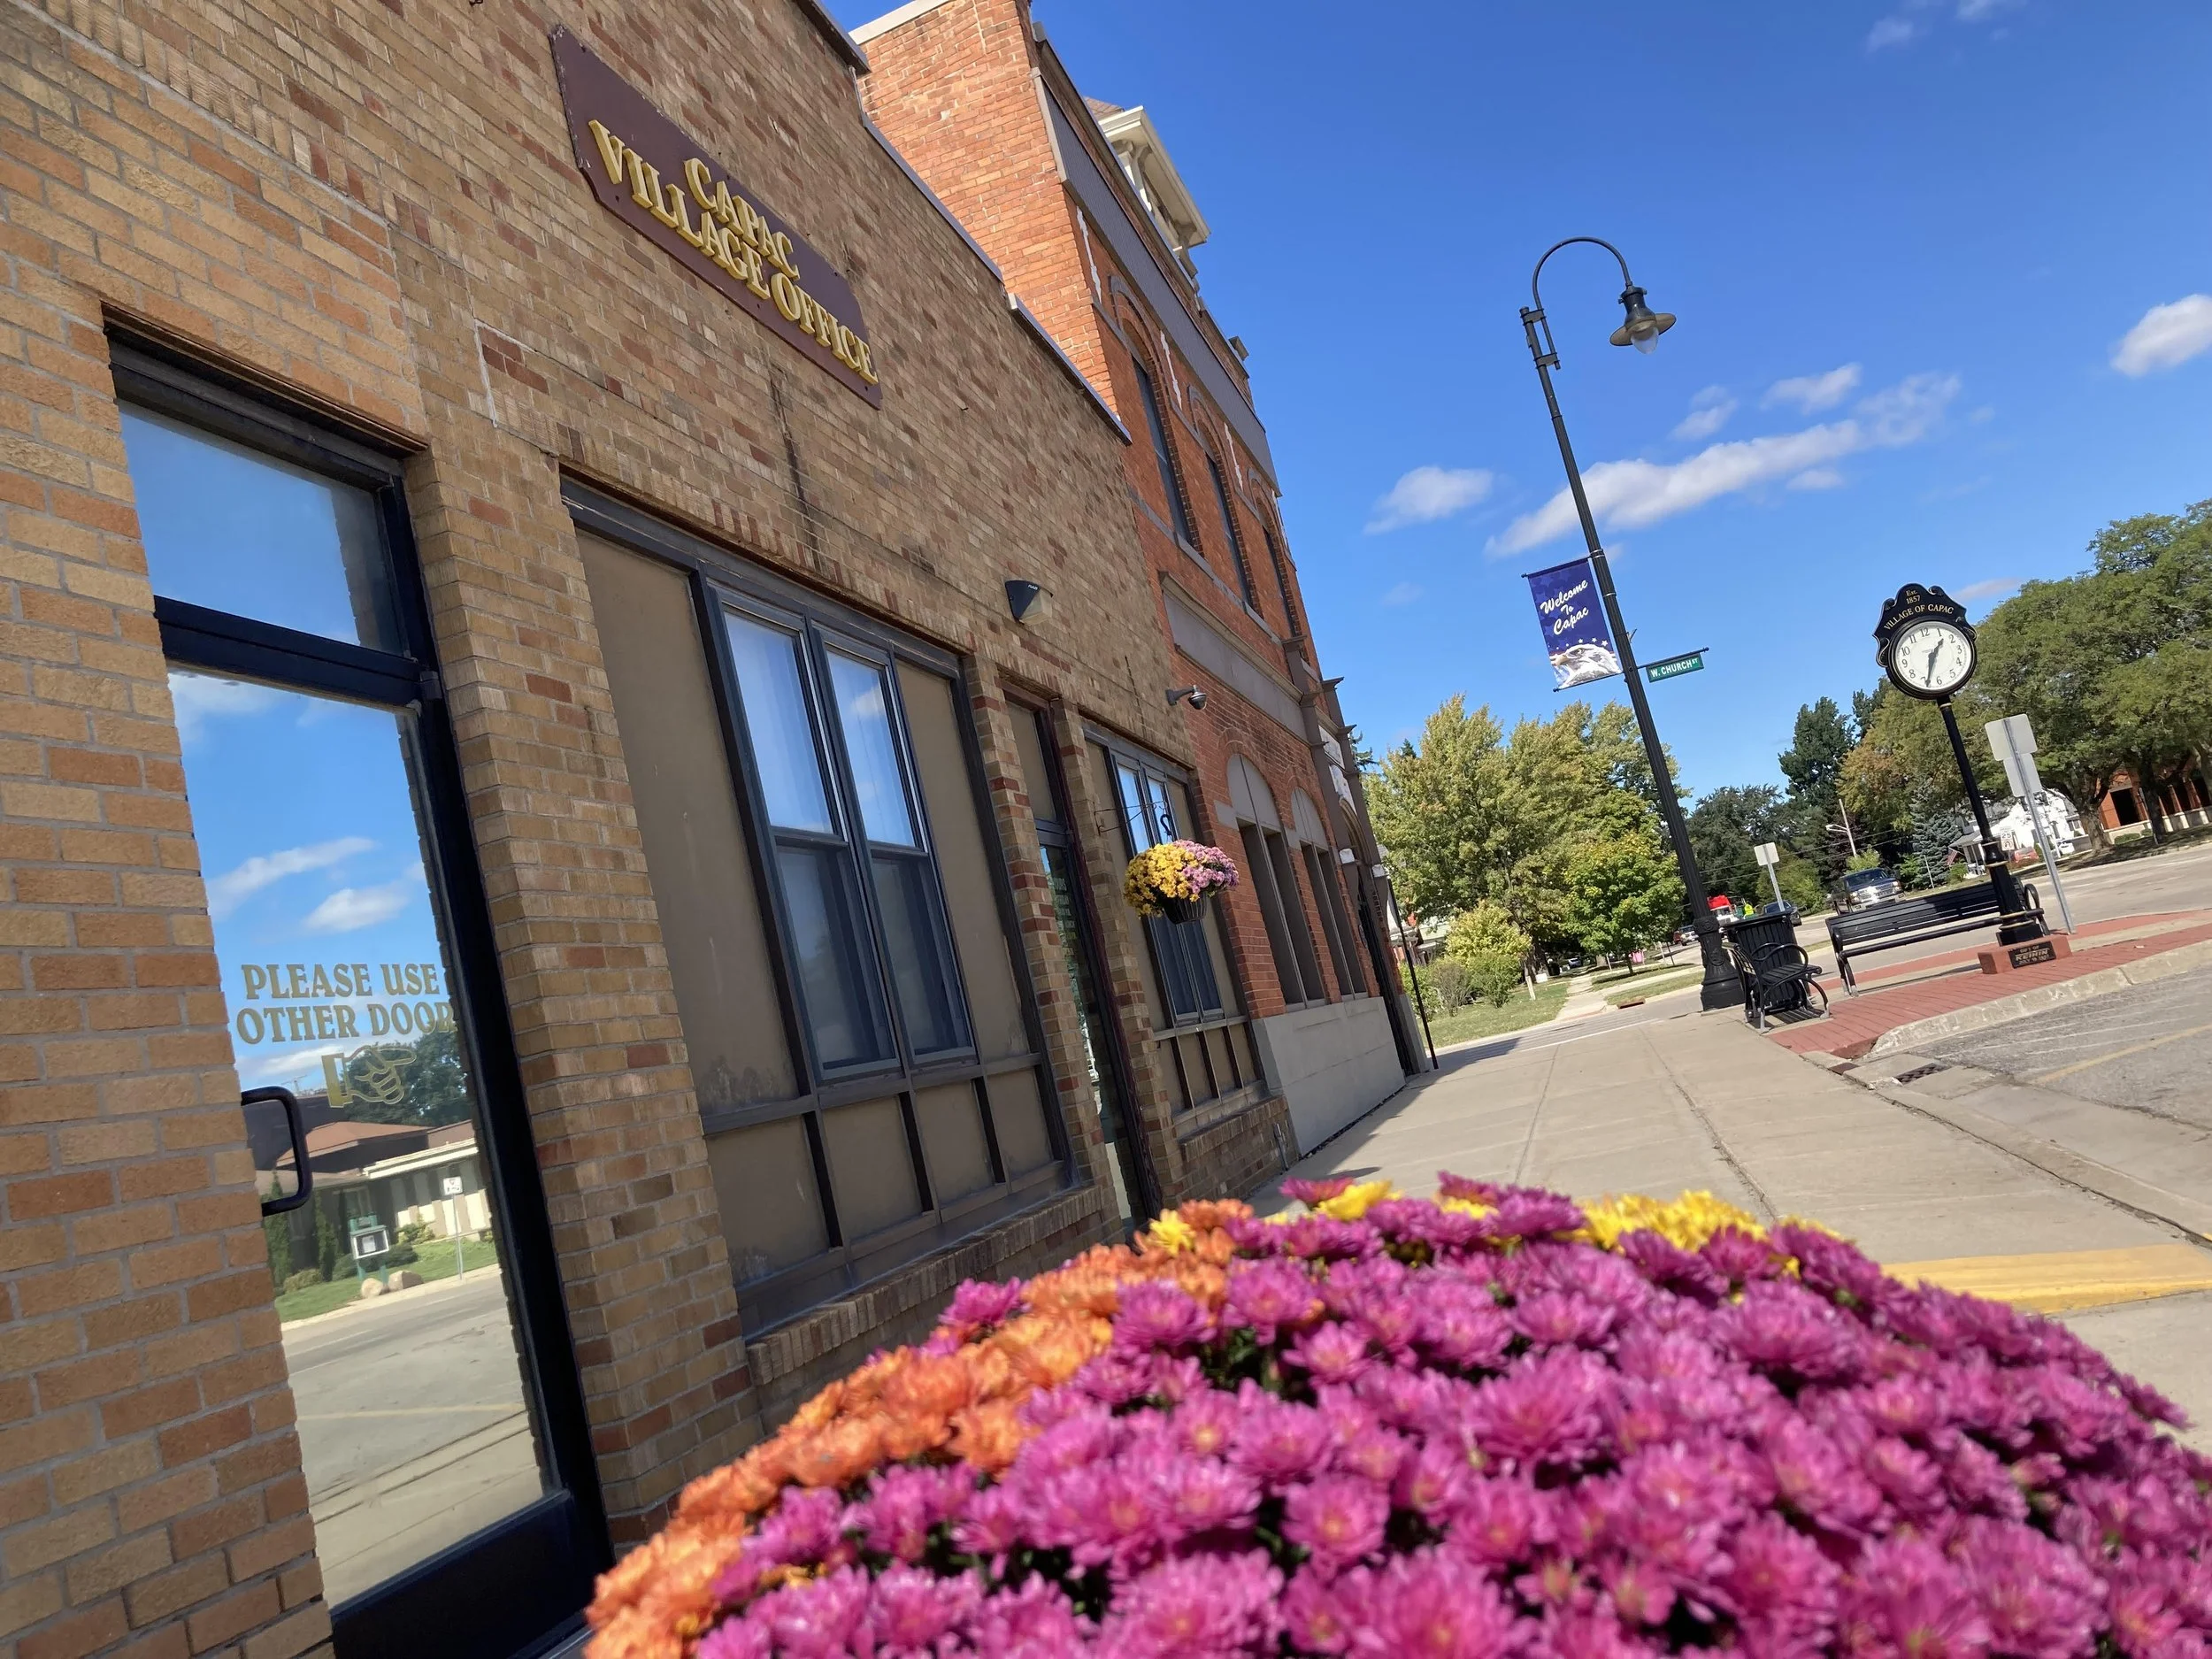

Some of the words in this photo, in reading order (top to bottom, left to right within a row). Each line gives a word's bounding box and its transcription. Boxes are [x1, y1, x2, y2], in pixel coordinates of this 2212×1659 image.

[684, 157, 800, 280] CAPAC
[588, 119, 771, 299] VILLAGE
[771, 273, 879, 385] OFFICE
[1540, 580, 1588, 614] Welcome
[1906, 595, 1921, 604] 1857
[1560, 603, 1574, 615] To
[1553, 607, 1589, 635] Capac
[1884, 608, 1914, 630] VILLAGE
[1915, 604, 1925, 613] OF
[1927, 603, 1955, 614] CAPAC
[1919, 627, 1930, 637] 12
[1937, 627, 1942, 637] 1
[1909, 634, 1916, 643] 11
[1949, 634, 1955, 643] 2
[1901, 646, 1910, 656] 10
[1956, 645, 1962, 654] 3
[1901, 659, 1908, 668] 9
[1956, 657, 1962, 666] 4
[1650, 668, 1661, 678] W.
[1661, 659, 1693, 675] CHURCH
[1949, 669, 1956, 678] 5
[1909, 669, 1916, 679] 8
[1936, 676, 1942, 685] 6
[242, 964, 373, 1000] PLEASE
[380, 964, 440, 995] USE
[236, 1004, 360, 1045] OTHER
[367, 1002, 458, 1036] DOOR
